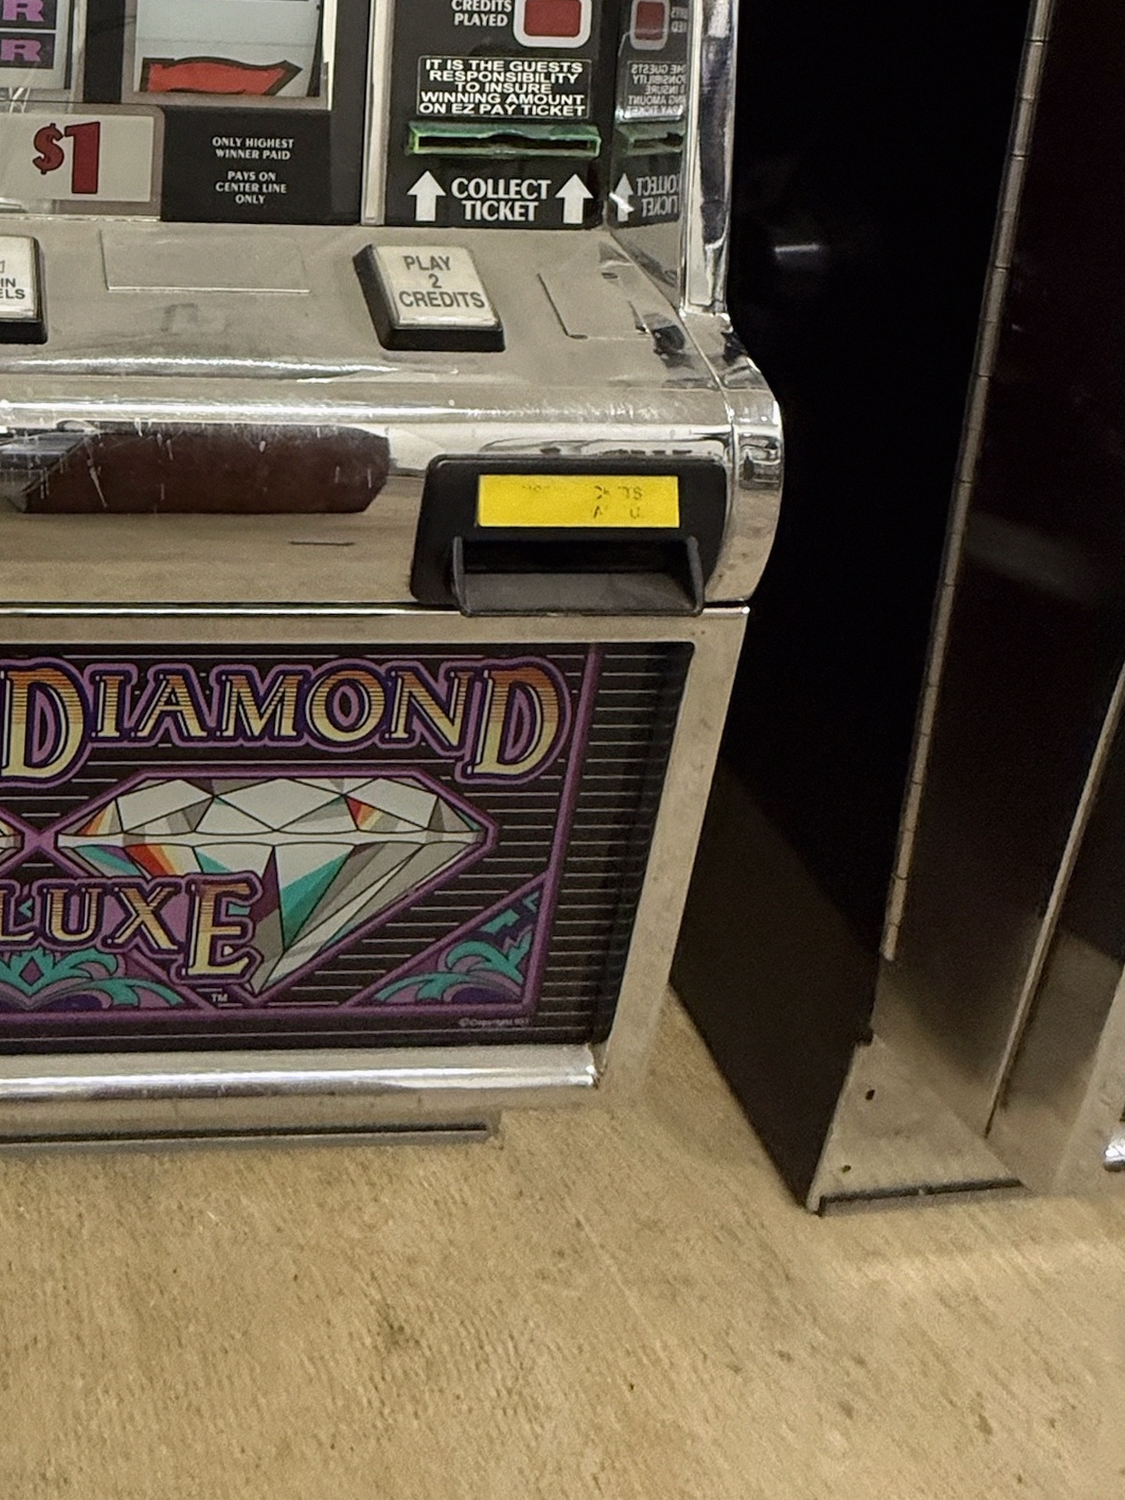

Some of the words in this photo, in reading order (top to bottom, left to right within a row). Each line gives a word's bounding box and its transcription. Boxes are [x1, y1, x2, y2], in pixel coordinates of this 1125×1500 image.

[453, 13, 508, 27] PLAYED
[425, 59, 442, 71] IT
[447, 59, 463, 71] IS
[468, 60, 504, 72] THE
[508, 61, 583, 73] GUESTS
[429, 70, 579, 84] RESPONSIBILITY
[455, 82, 480, 93] TO
[485, 83, 552, 94] INSURE
[421, 92, 501, 104] WINNING
[506, 94, 585, 105] AMOUNT
[419, 103, 448, 114] ON
[452, 104, 475, 114] EZ
[479, 105, 517, 115] PAY
[522, 105, 585, 116] TICKET
[212, 136, 242, 147] ONLY
[245, 137, 294, 149] HIGHEST
[32, 121, 100, 195] $1
[215, 148, 260, 159] WINNER
[262, 150, 291, 160] PAID
[227, 170, 256, 180] PAYS
[258, 171, 276, 181] ON
[215, 182, 260, 192] CENTER
[262, 183, 287, 193] LINE
[451, 177, 551, 199] COLLECT
[235, 194, 266, 204] ONLY
[461, 200, 538, 221] TICKET
[402, 255, 452, 271] PLAY
[428, 273, 442, 289] 2
[398, 290, 486, 308] CREDITS
